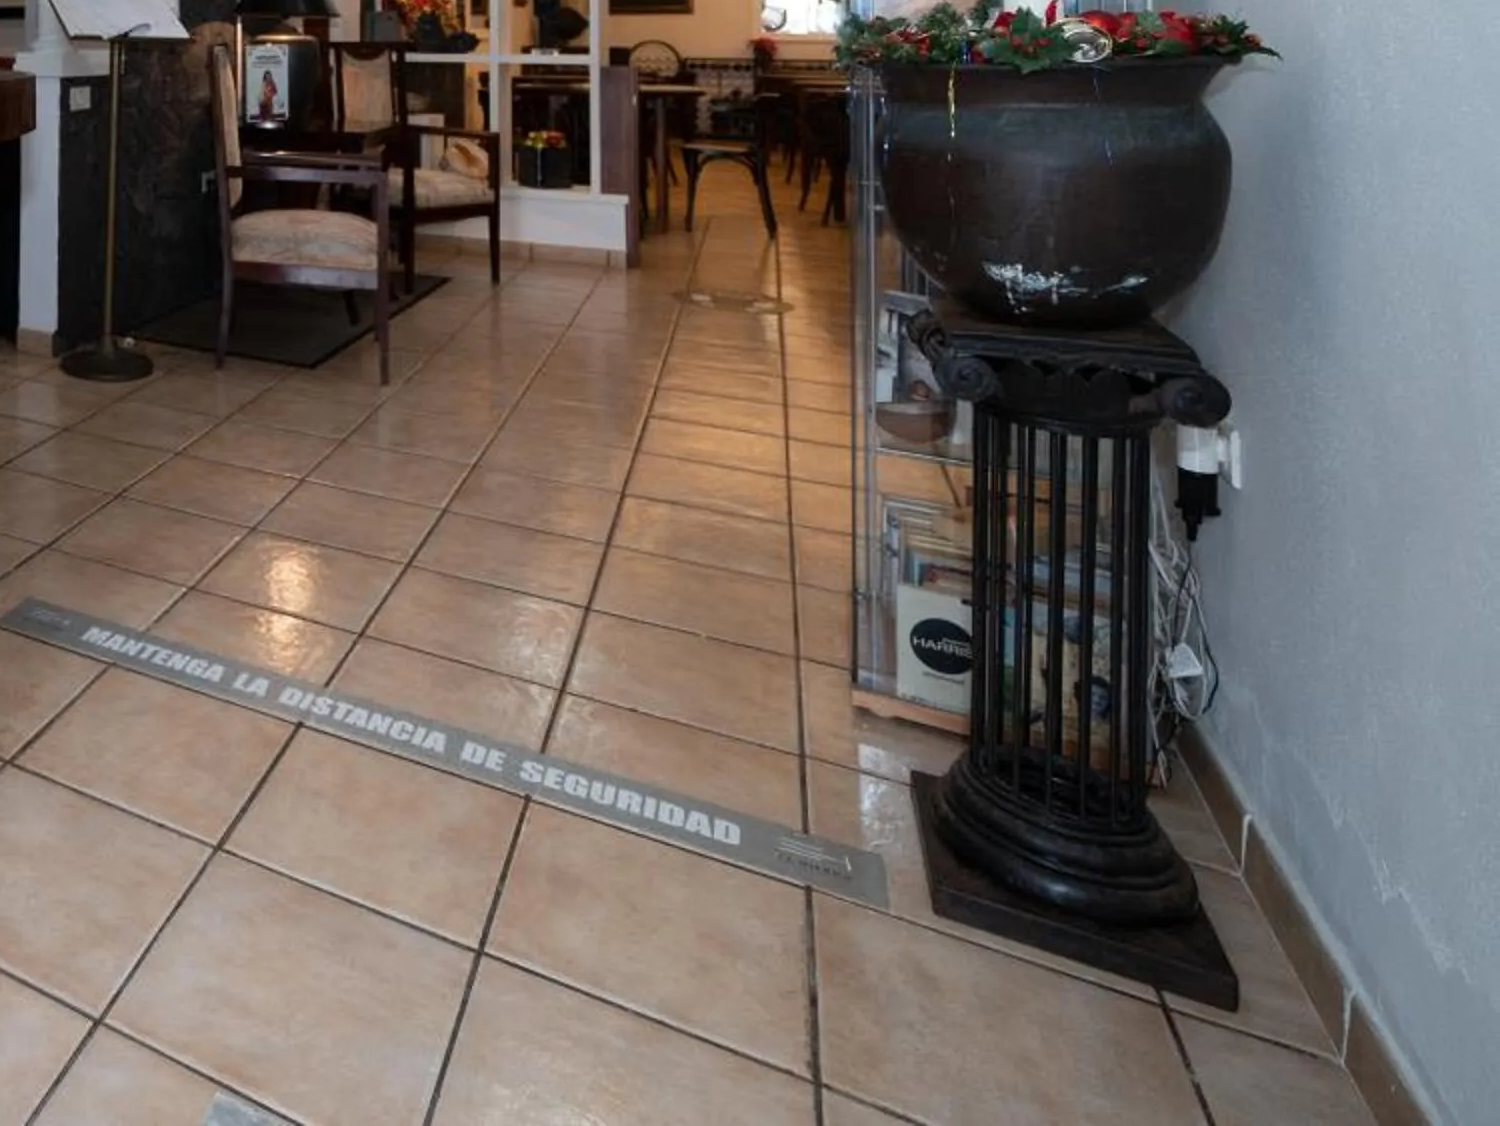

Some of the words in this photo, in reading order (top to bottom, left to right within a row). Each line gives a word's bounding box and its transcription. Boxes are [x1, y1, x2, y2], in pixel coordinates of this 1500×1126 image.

[80, 626, 225, 683] MANTENGA
[232, 674, 270, 697] LA
[278, 686, 448, 754] DISTANCIA
[460, 740, 507, 772] DE
[520, 760, 741, 845] SEGURIDAD
